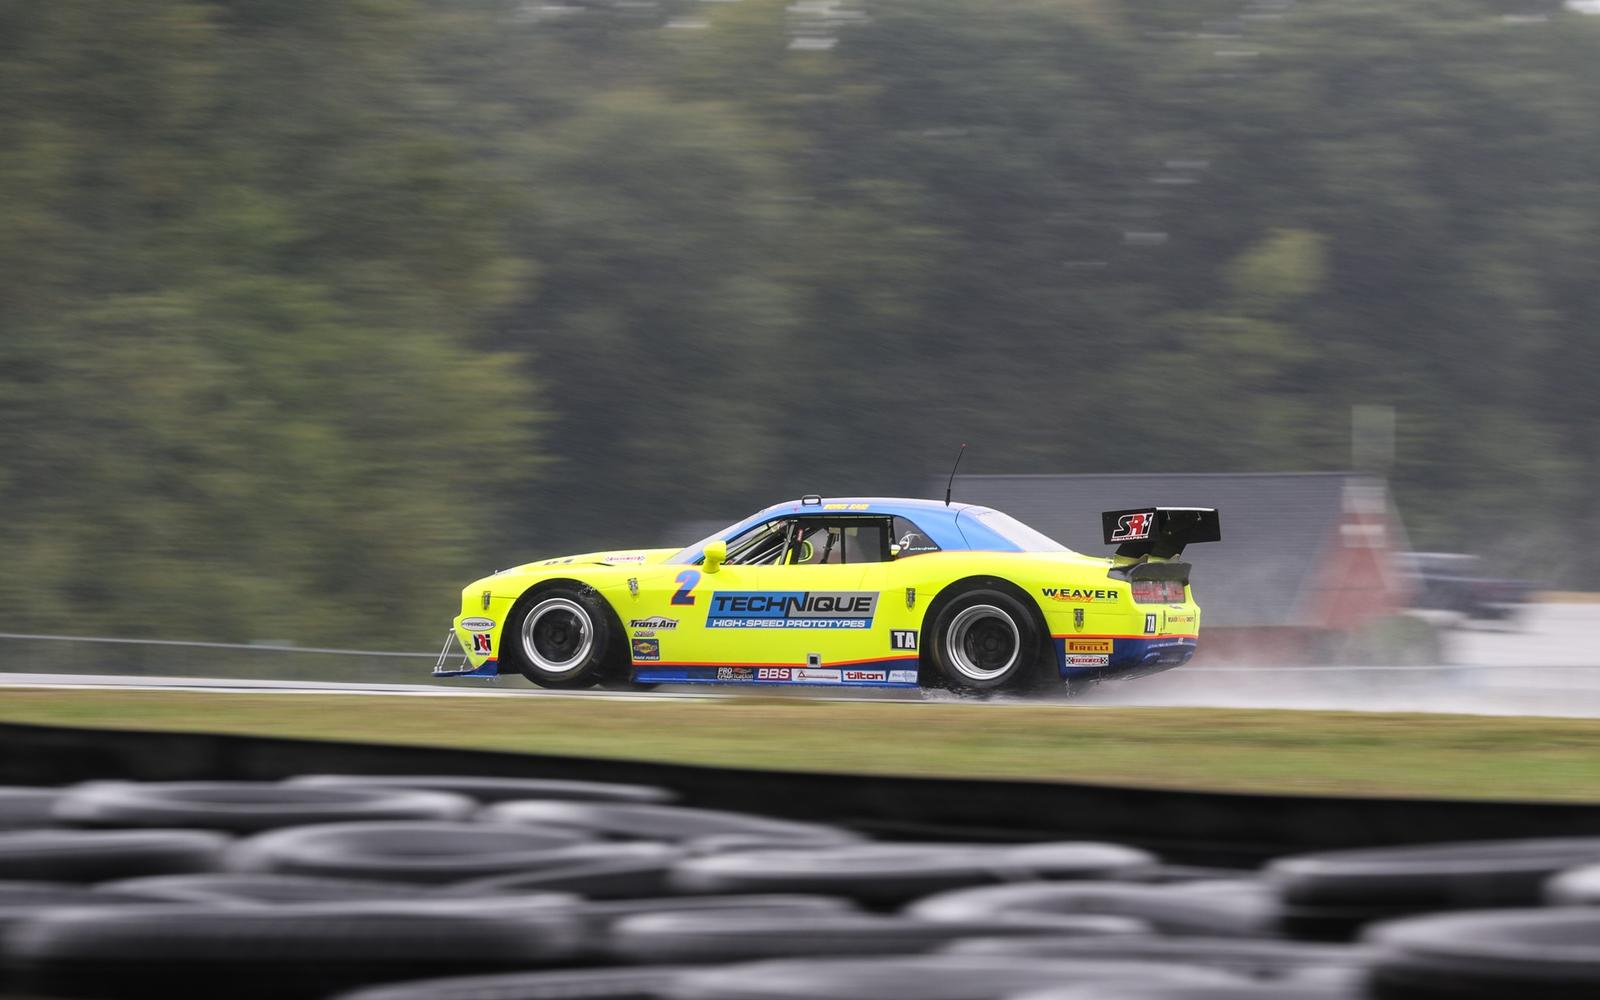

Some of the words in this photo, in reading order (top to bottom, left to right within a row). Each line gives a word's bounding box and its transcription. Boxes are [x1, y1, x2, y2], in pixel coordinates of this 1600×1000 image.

[670, 569, 701, 606] 2
[1042, 588, 1118, 599] WEAVER
[715, 592, 873, 617] TECHNIQUE
[630, 620, 657, 628] Trans
[658, 620, 677, 628] Am
[713, 619, 784, 627] HIGH-SPEED
[786, 619, 866, 628] PROTOTYPES
[1146, 615, 1155, 632] TA
[894, 631, 916, 648] TA
[1069, 642, 1109, 651] PIRELLI
[758, 668, 790, 679] BBS
[845, 671, 884, 680] tilton
